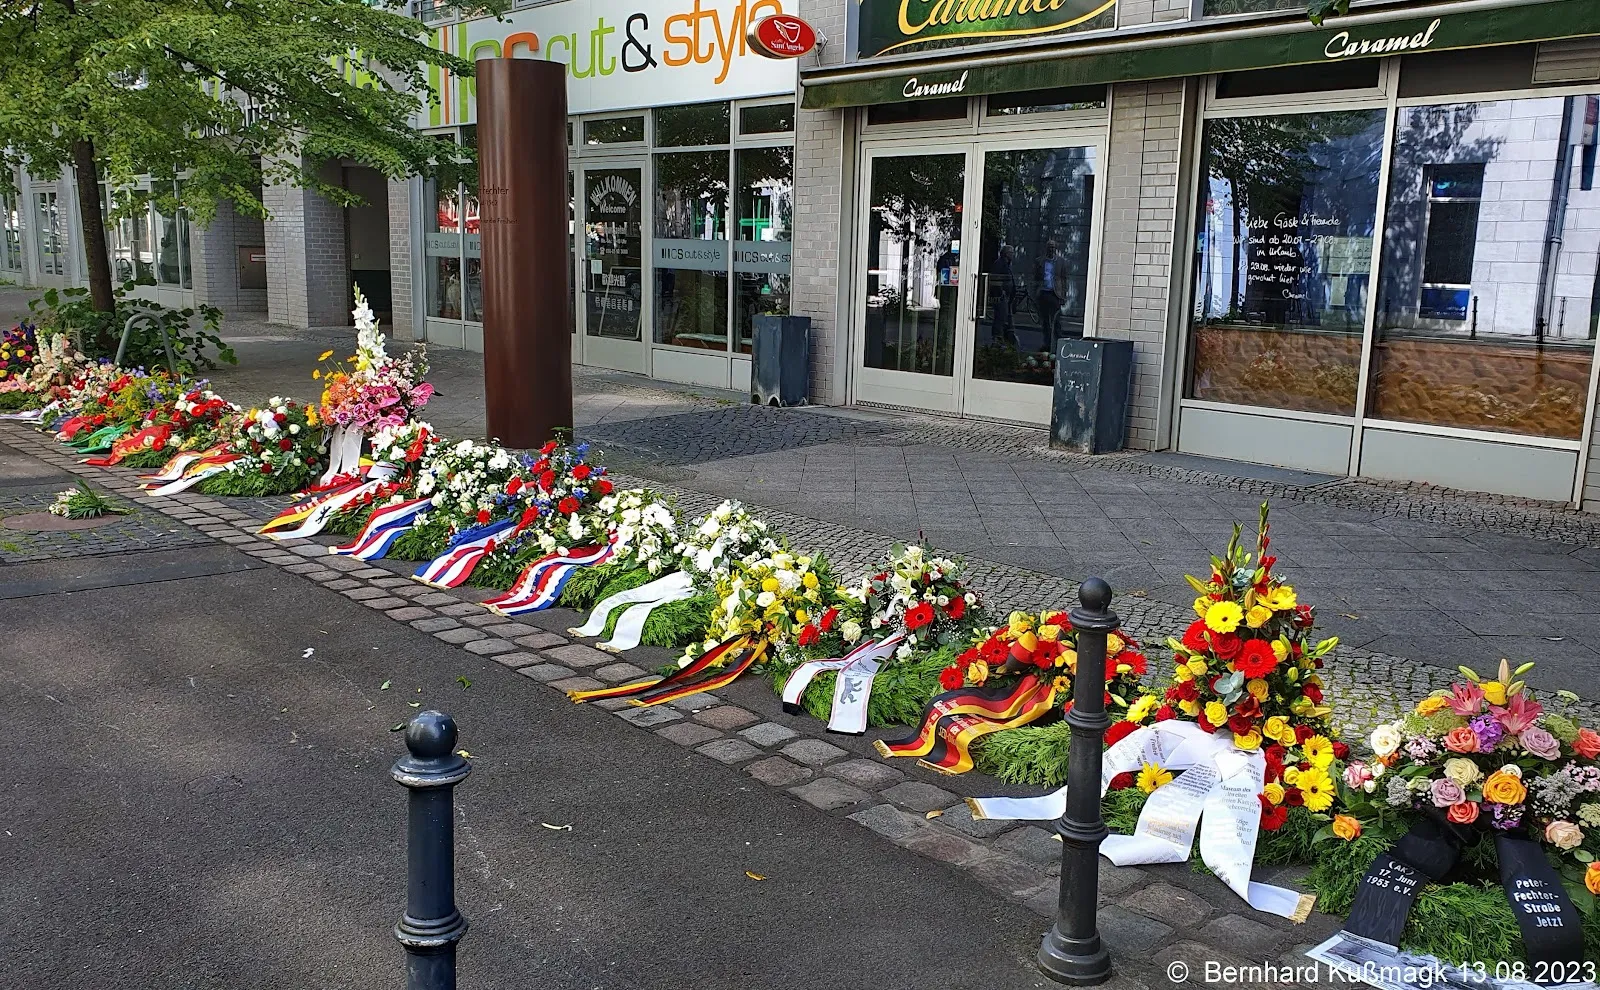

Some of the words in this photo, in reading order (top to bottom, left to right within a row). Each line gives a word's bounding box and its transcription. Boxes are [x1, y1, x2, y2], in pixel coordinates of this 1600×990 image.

[621, 13, 658, 72] &
[1324, 18, 1441, 58] Caramel
[902, 69, 969, 98] Caramel
[589, 174, 638, 207] WILLKOMMEN
[599, 200, 627, 214] Welcome
[1244, 213, 1269, 229] Liebe
[1248, 235, 1266, 244] sind
[1268, 233, 1280, 245] ab
[1366, 875, 1391, 888] 1953
[1378, 868, 1392, 879] 17.
[1394, 874, 1418, 887] Juni
[1515, 878, 1549, 889] Peter-
[1513, 890, 1559, 902] Fechter-
[1523, 902, 1562, 914] Straße
[1536, 916, 1564, 928] Jetzt
